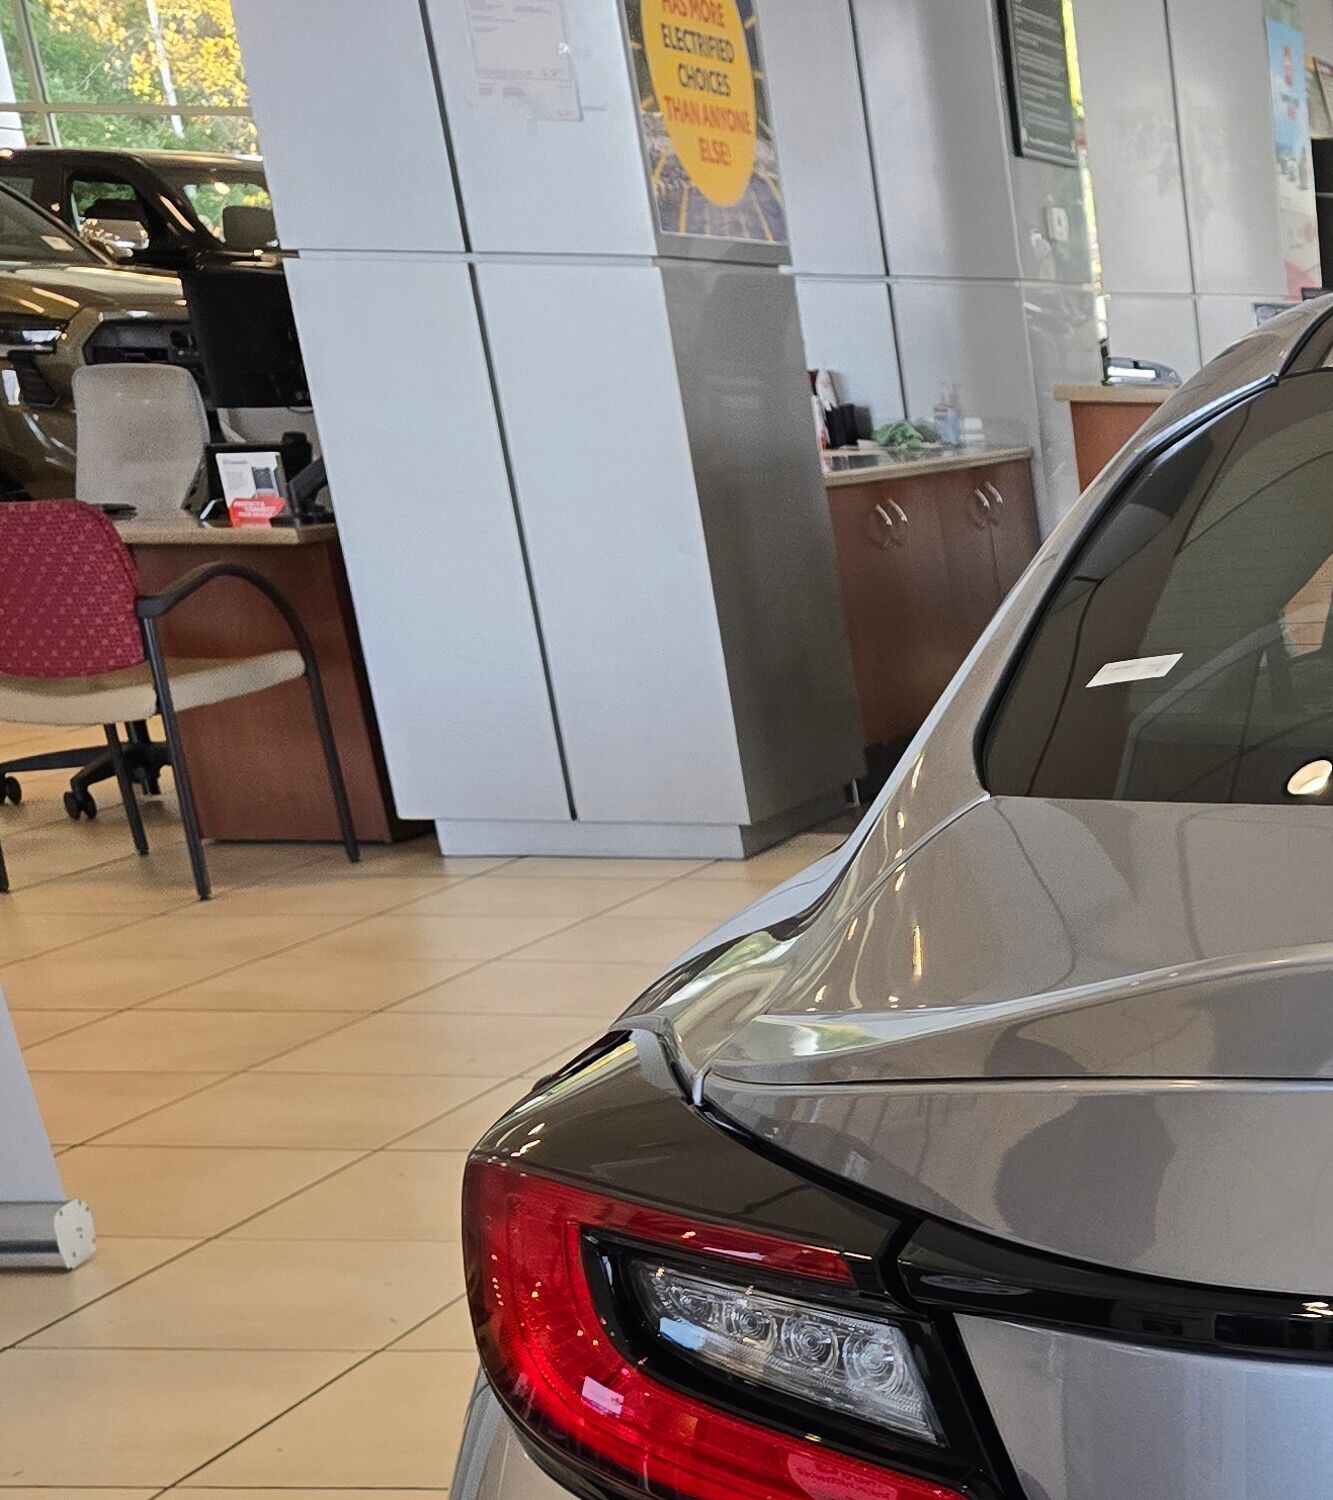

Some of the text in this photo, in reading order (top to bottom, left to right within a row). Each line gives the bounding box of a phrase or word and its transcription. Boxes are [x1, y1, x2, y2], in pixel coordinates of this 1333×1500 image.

[661, 24, 735, 63] ELECTRIFIED
[678, 63, 731, 97] CHOICES
[663, 96, 752, 134] THAN ANYONE
[699, 138, 733, 165] ELSE!
